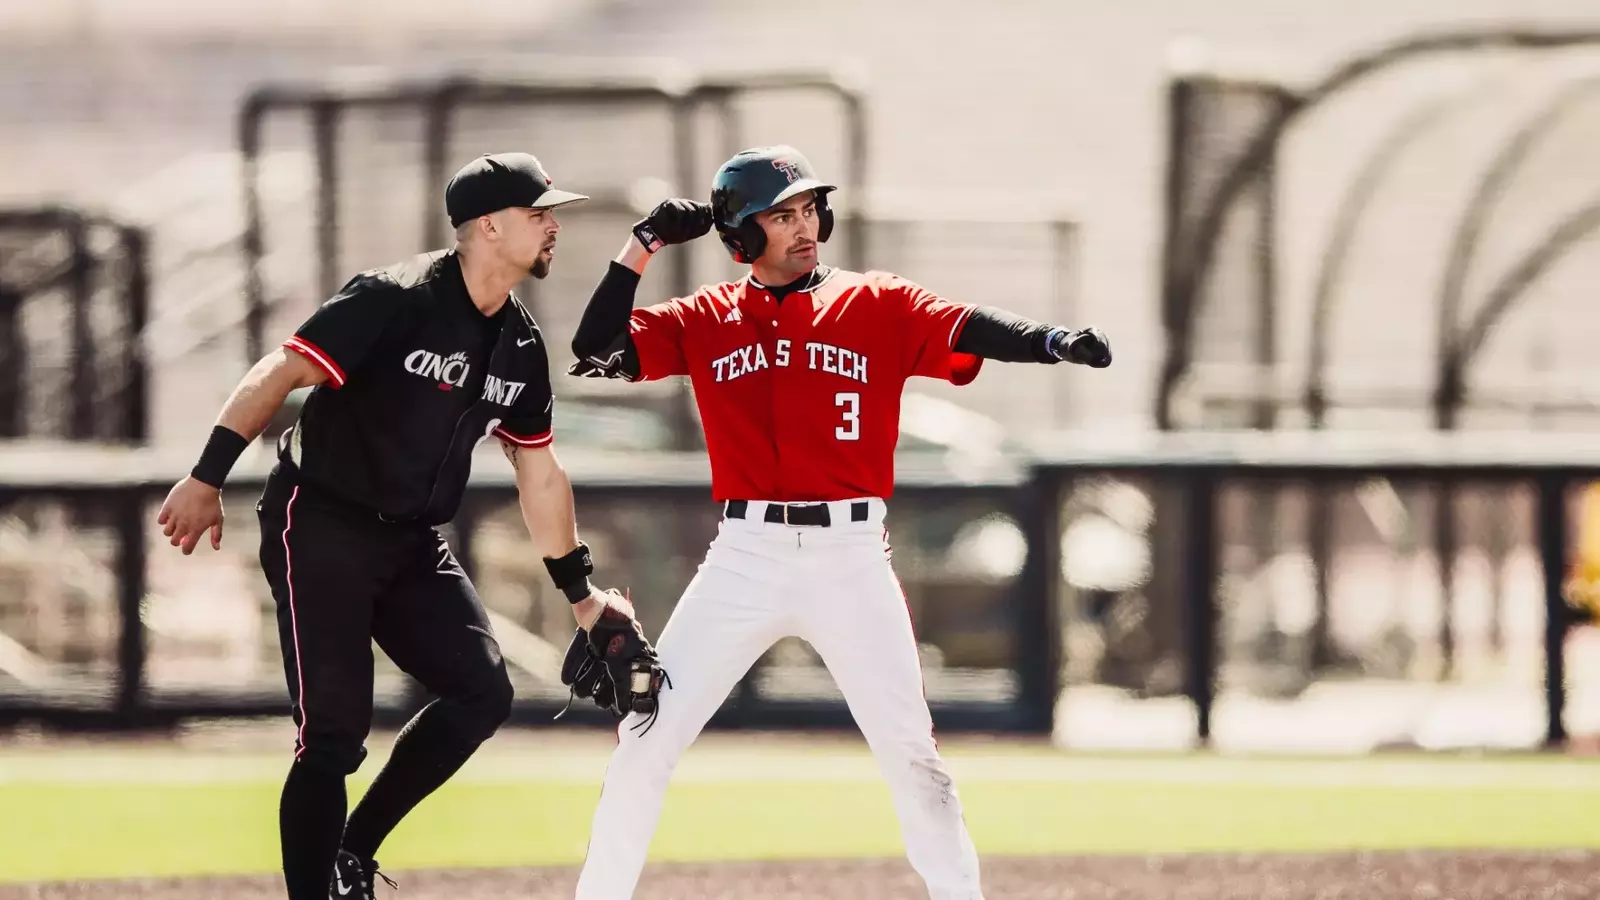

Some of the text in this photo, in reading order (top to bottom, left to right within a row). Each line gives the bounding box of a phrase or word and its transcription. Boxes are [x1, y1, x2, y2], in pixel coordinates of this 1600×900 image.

[711, 339, 868, 384] TEXAS TECH
[834, 391, 861, 441] 3
